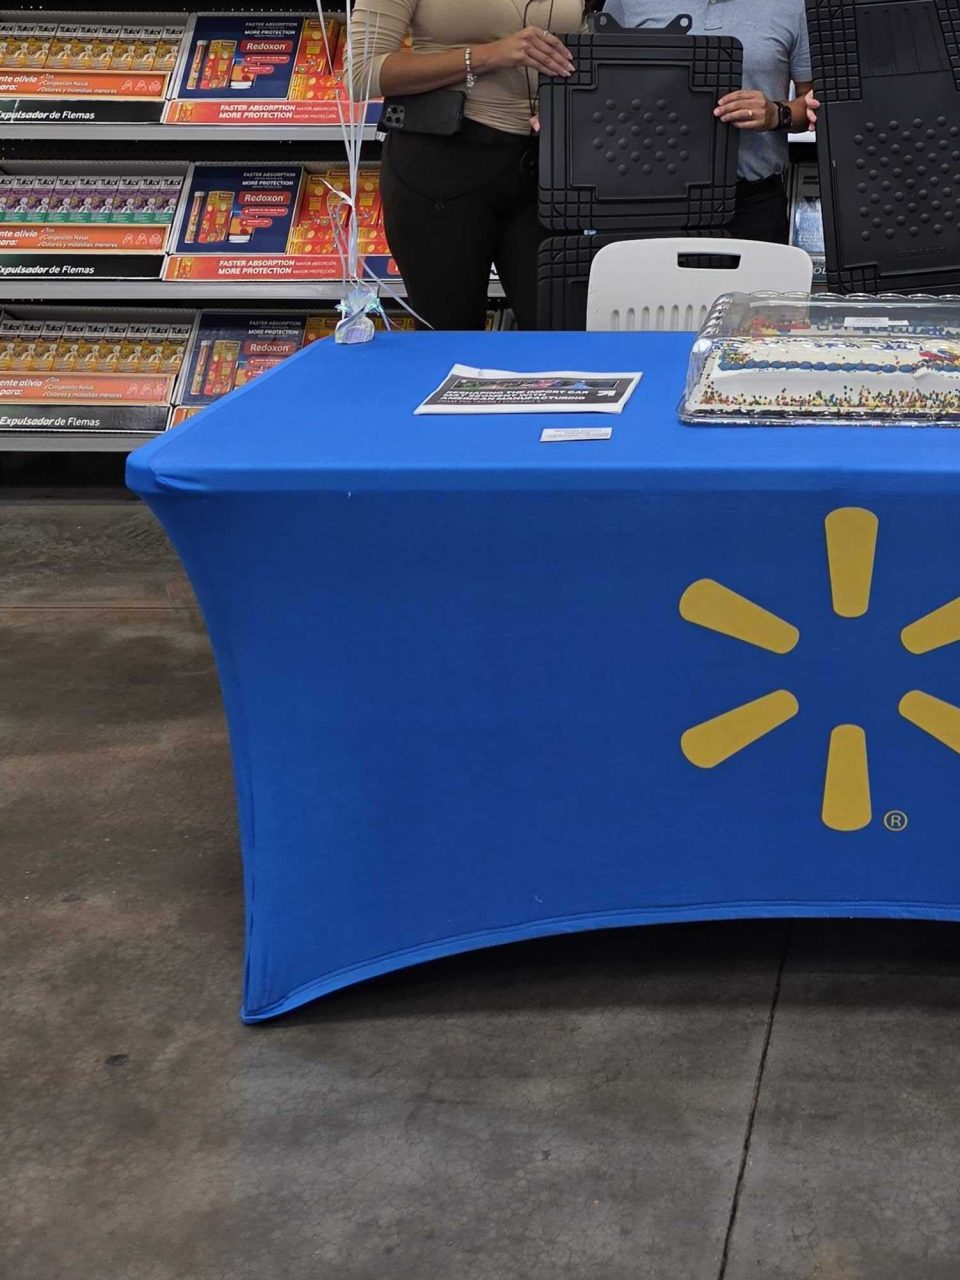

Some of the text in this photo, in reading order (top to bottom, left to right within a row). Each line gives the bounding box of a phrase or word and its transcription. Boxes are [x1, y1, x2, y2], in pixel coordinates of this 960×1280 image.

[246, 42, 286, 50] Redoxon
[50, 111, 60, 119] de
[62, 111, 95, 120] Flemas
[244, 194, 284, 202] Redoxon
[62, 266, 94, 274] Flemas
[250, 344, 290, 352] Redoxon
[1, 416, 100, 426] Expulsador de Flemas
